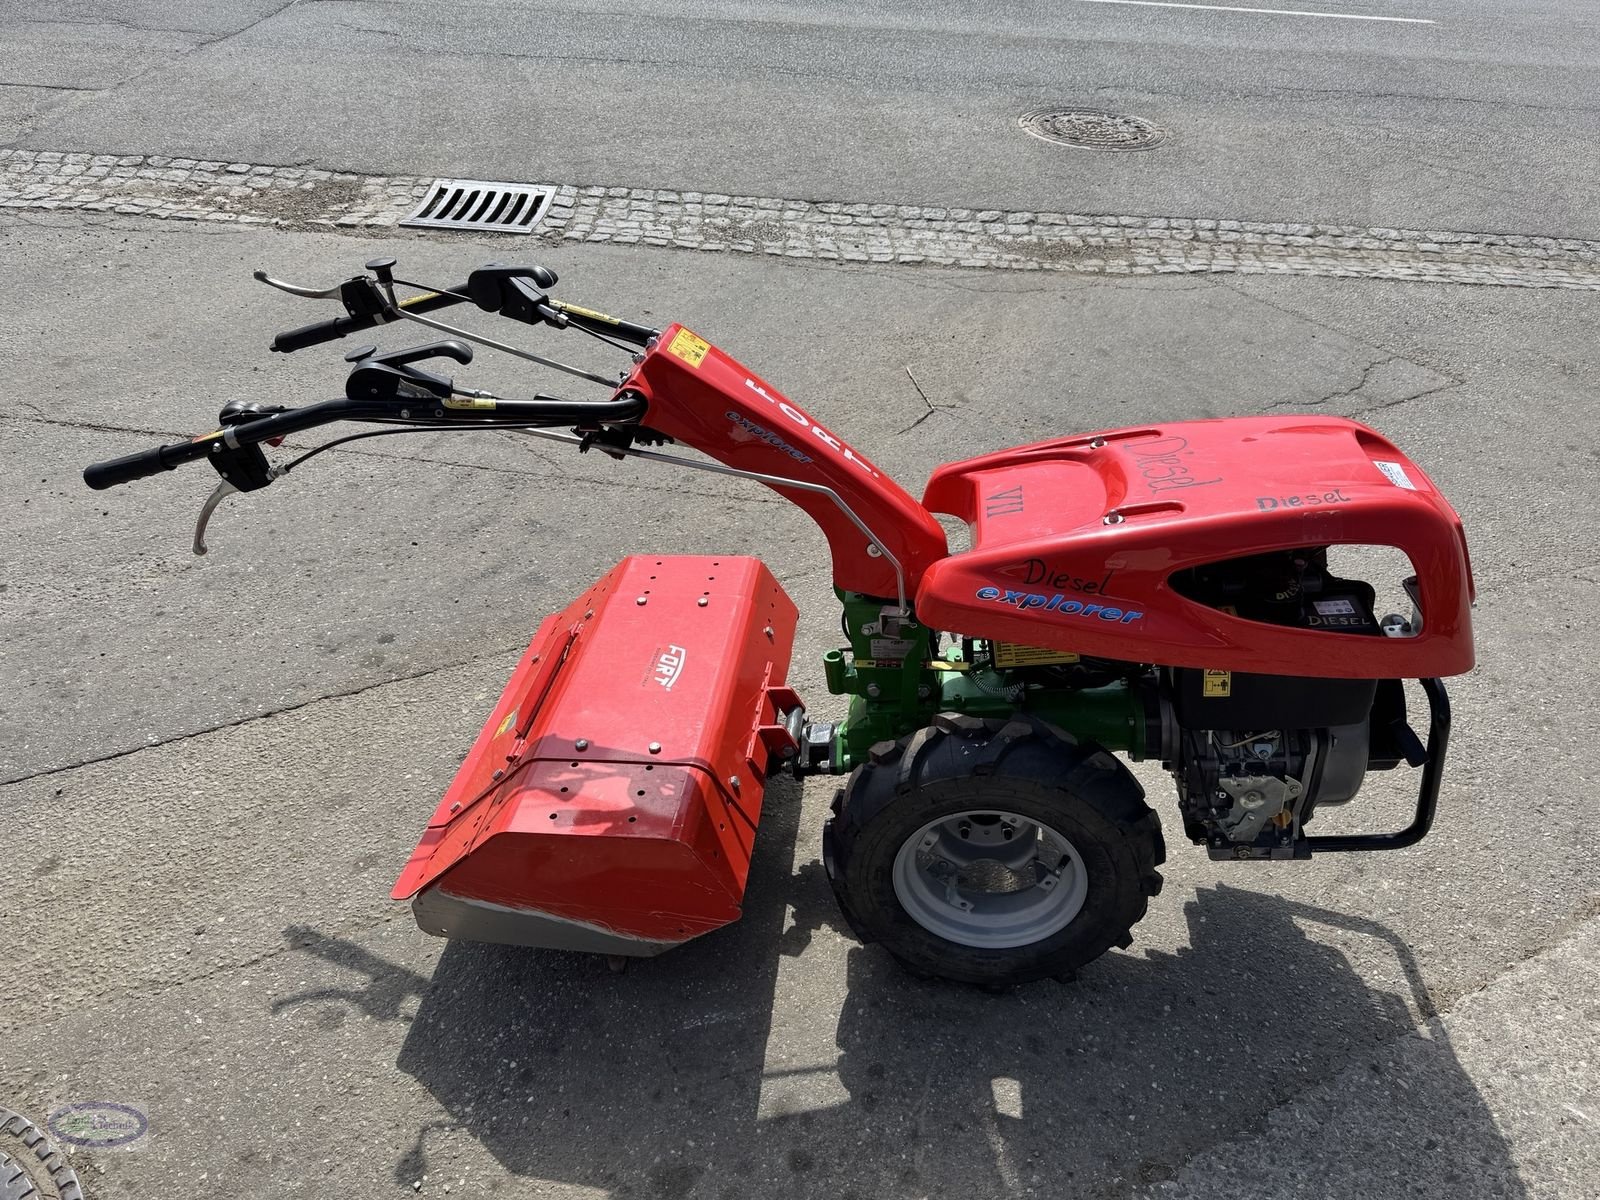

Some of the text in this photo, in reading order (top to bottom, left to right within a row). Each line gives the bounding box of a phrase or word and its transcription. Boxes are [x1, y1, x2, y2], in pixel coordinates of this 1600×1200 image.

[725, 411, 814, 463] explorer
[1123, 436, 1223, 494] Diesel
[1255, 488, 1352, 513] Diesel
[1024, 558, 1115, 596] Diesel
[975, 586, 1144, 625] explorer
[1308, 615, 1371, 626] DIESEL
[654, 643, 686, 690] FORT
